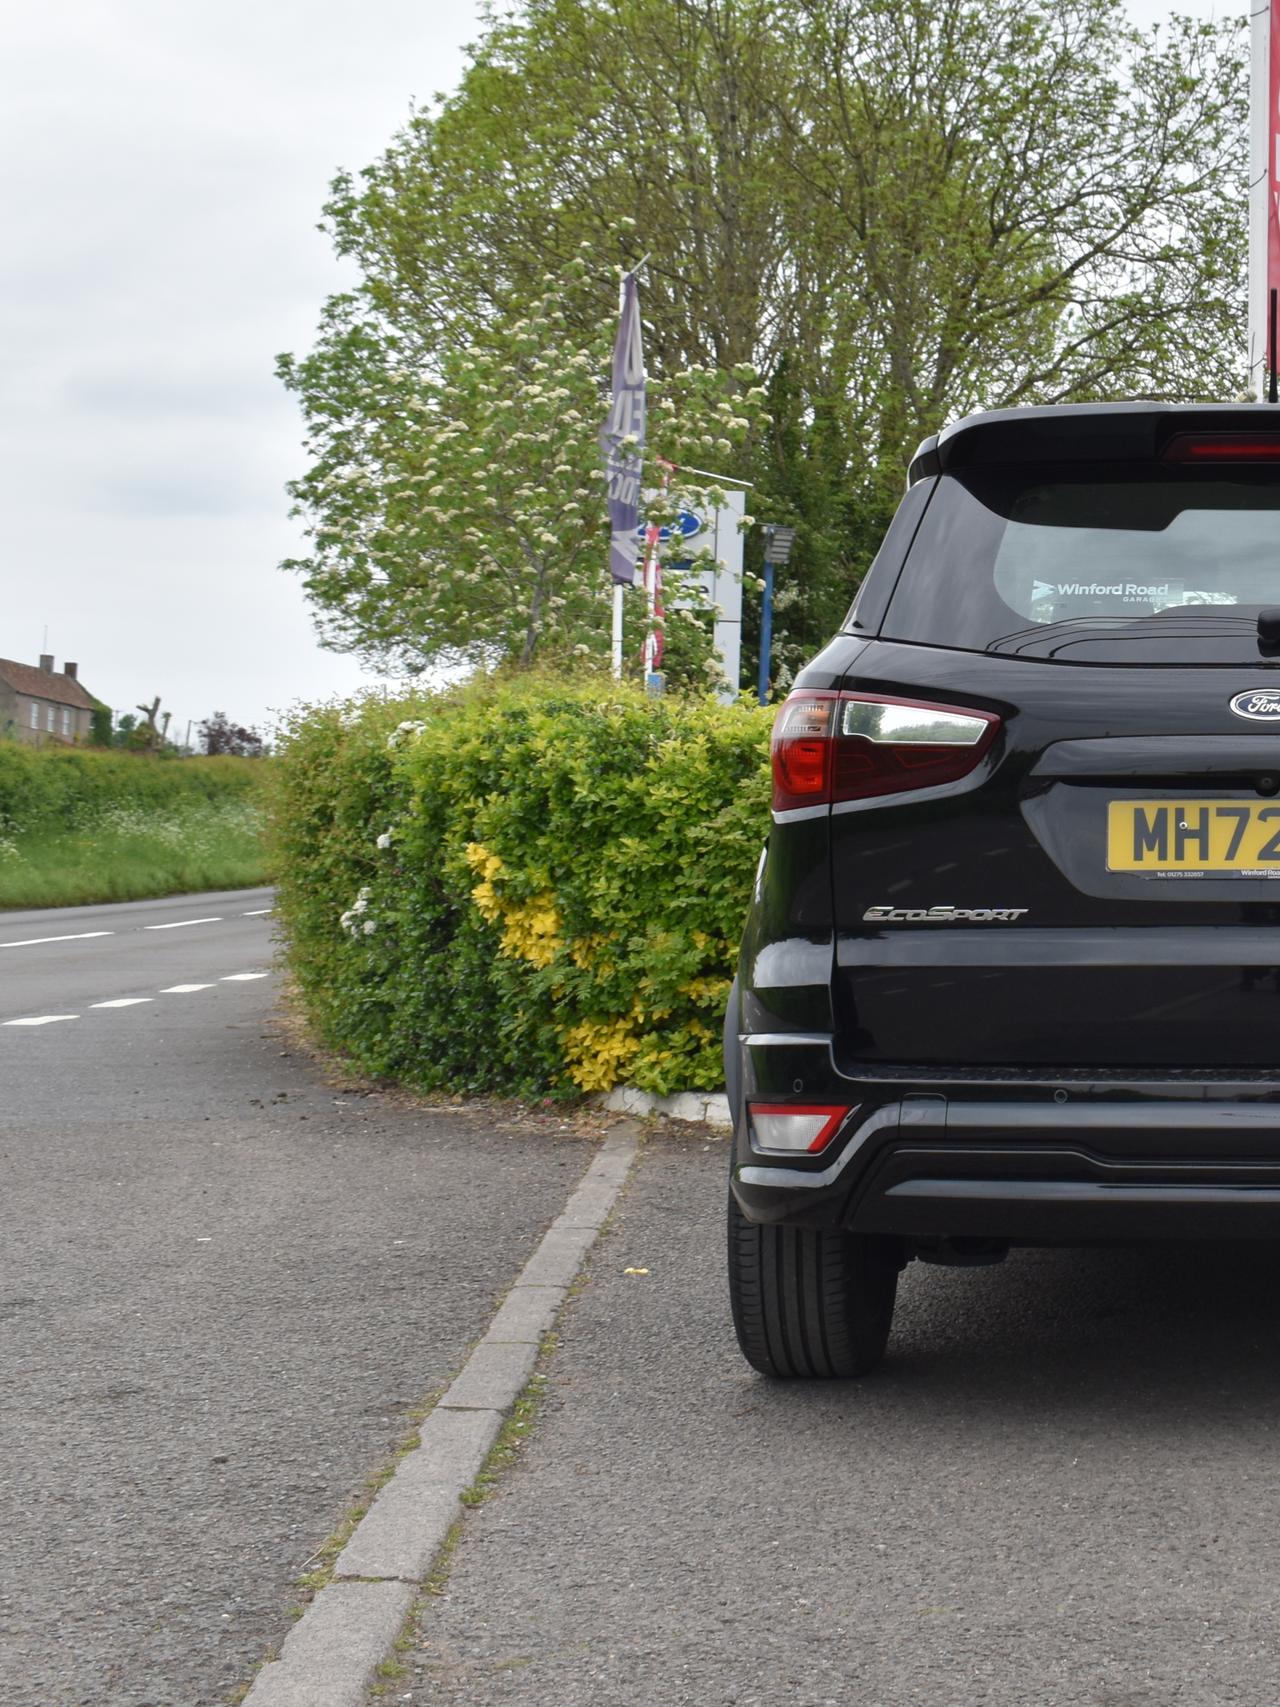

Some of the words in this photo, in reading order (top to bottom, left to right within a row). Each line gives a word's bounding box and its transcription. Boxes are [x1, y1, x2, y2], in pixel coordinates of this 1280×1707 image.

[1057, 583, 1122, 595] Winford
[1125, 584, 1169, 595] Road
[1240, 869, 1267, 877] Winford
